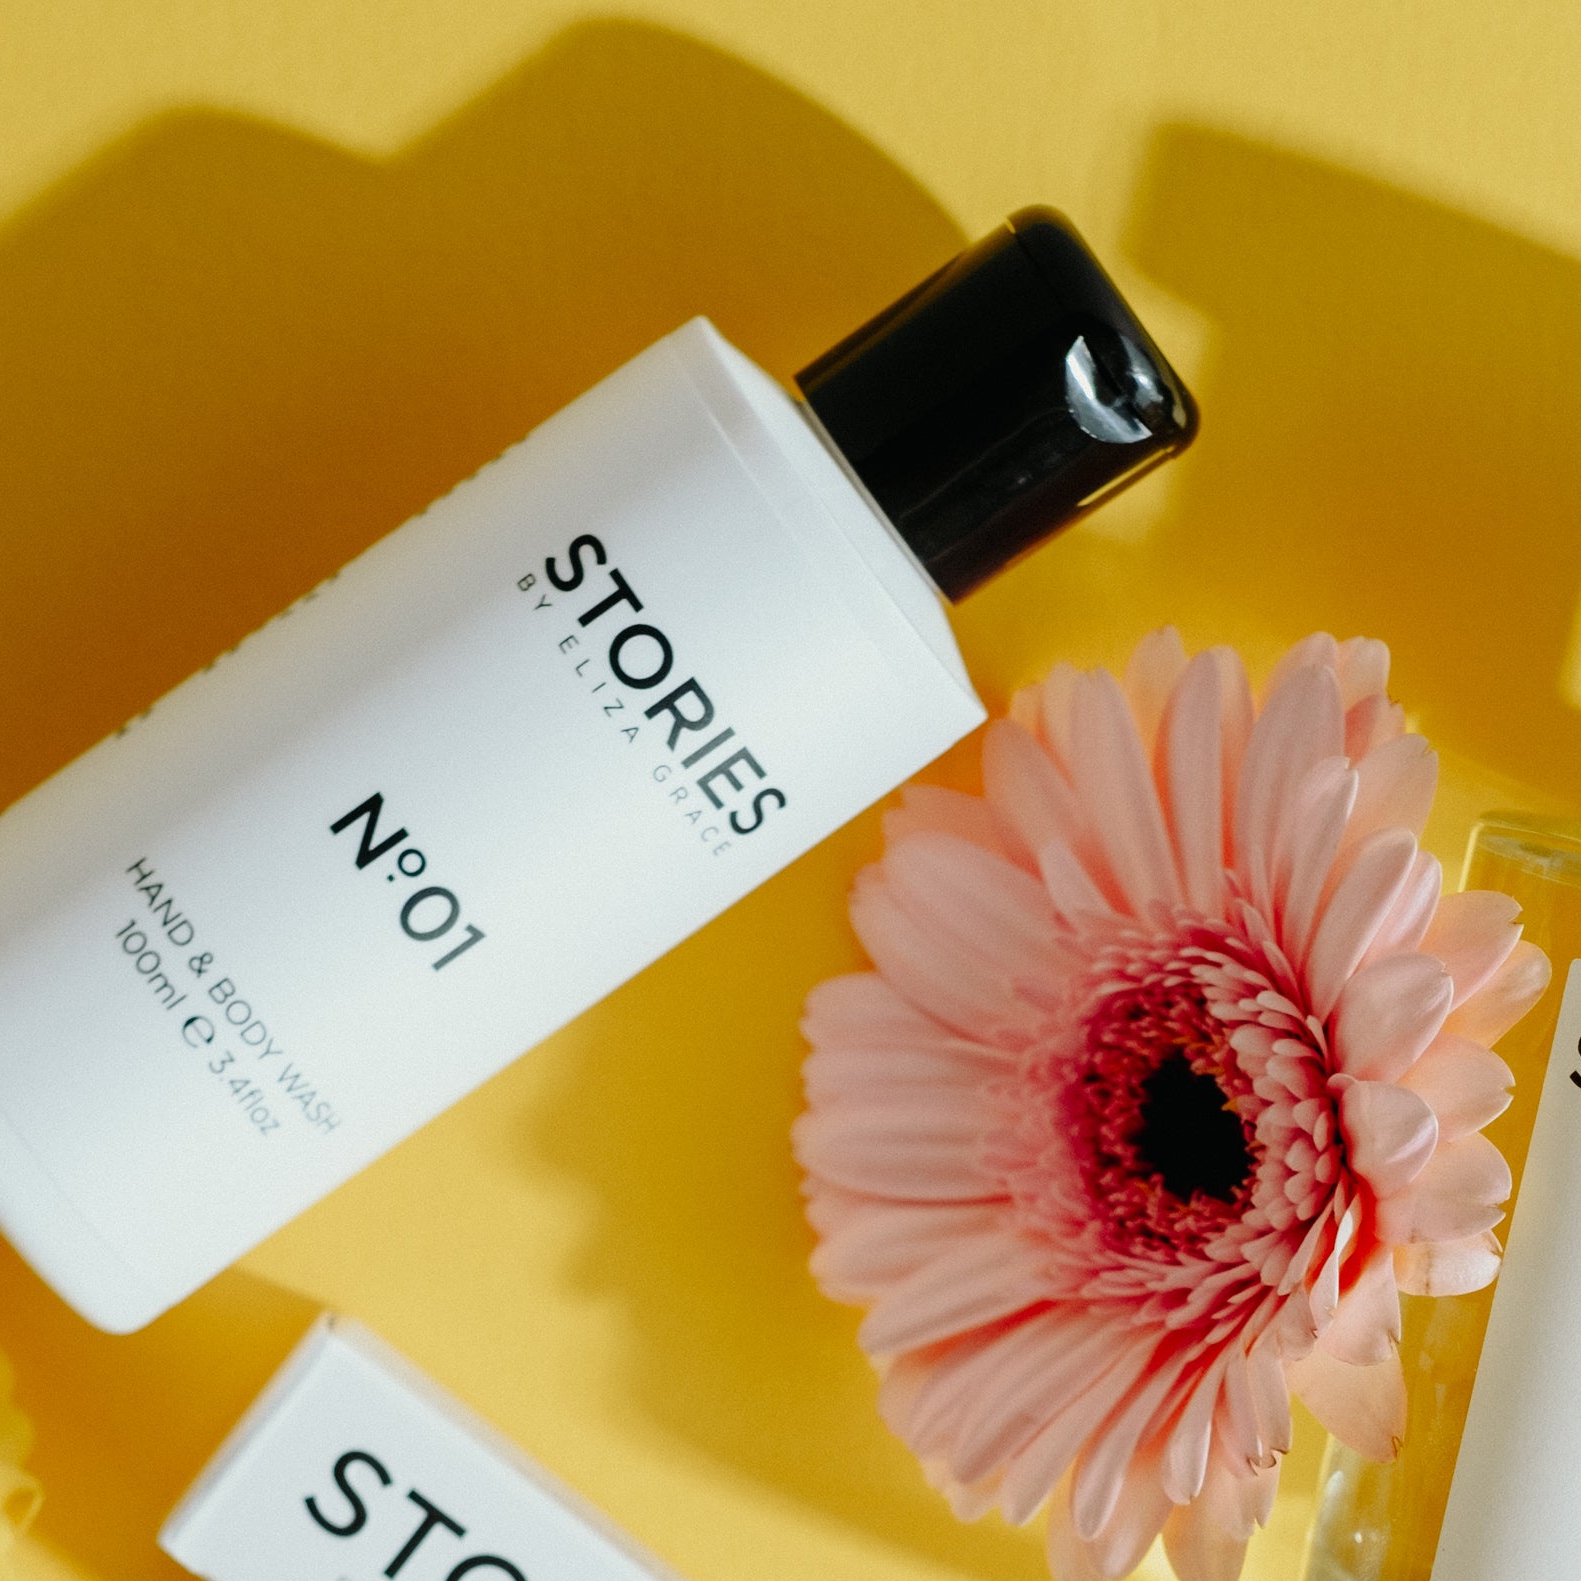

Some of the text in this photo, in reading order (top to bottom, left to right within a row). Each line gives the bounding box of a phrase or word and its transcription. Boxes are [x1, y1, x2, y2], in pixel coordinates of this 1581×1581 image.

[516, 572, 732, 856] BY ELIZA GRACE
[545, 534, 787, 835] STORIES
[115, 918, 188, 1011] 100ml
[125, 857, 342, 1136] HAND & BODY WASH
